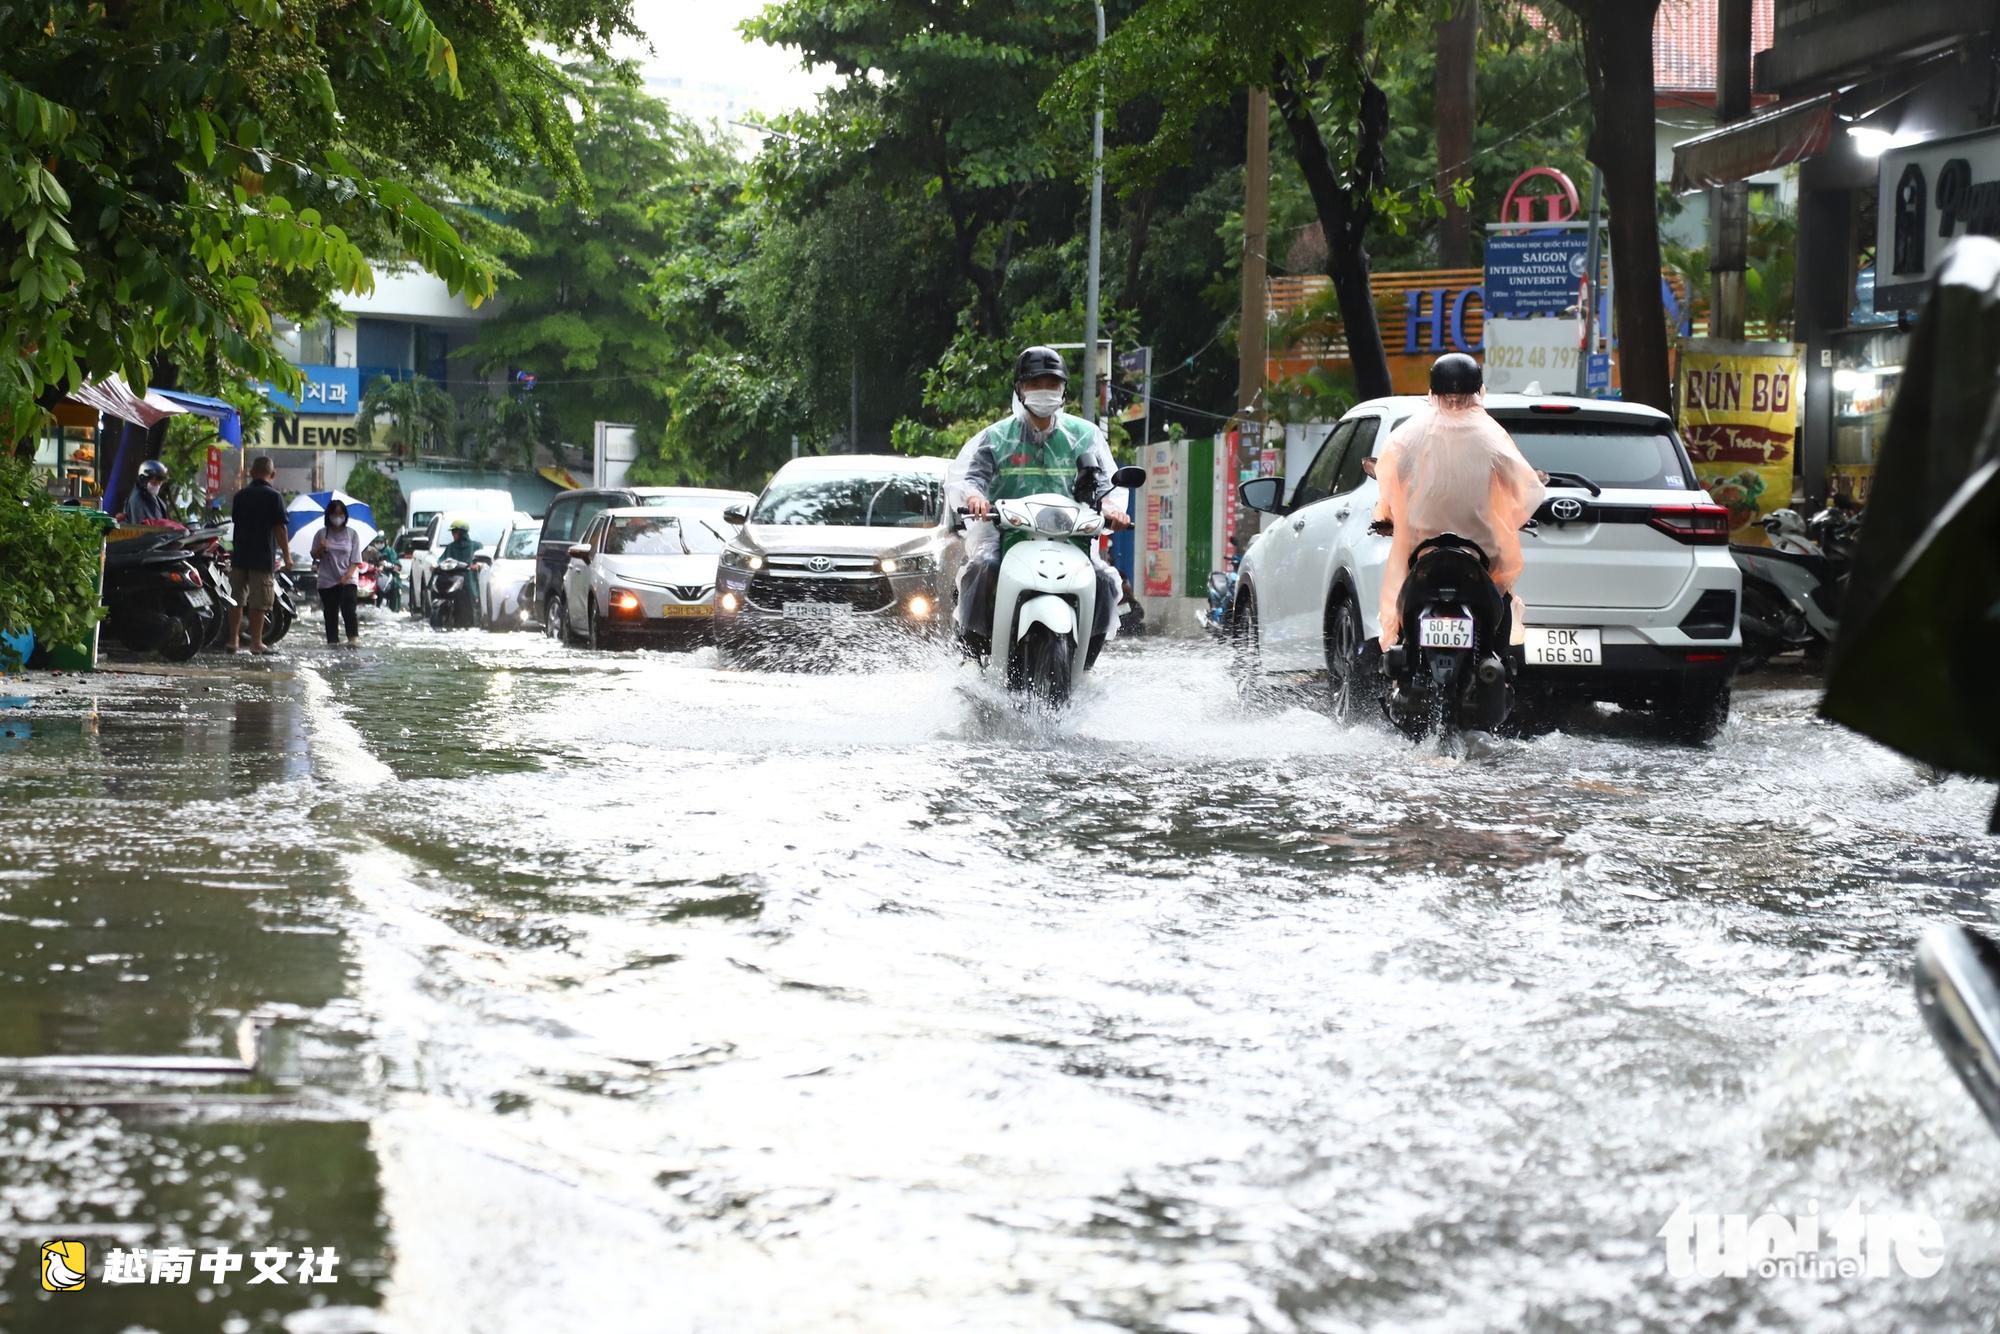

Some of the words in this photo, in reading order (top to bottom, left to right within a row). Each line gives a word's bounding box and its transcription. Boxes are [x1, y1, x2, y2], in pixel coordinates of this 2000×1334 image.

[1522, 253, 1567, 262] SAIGON
[1490, 265, 1568, 275] INTERNATIONAL
[1509, 276, 1567, 285] UNIVERSITY
[1488, 346, 1523, 369] 0922
[1528, 346, 1546, 369] 48
[1687, 362, 1742, 411] BÚN
[1752, 364, 1790, 412] BÒ
[1429, 620, 1465, 632] 60-F4
[1425, 633, 1470, 646] 100.67
[1547, 630, 1578, 645] 60K
[1537, 648, 1593, 663] 166.90
